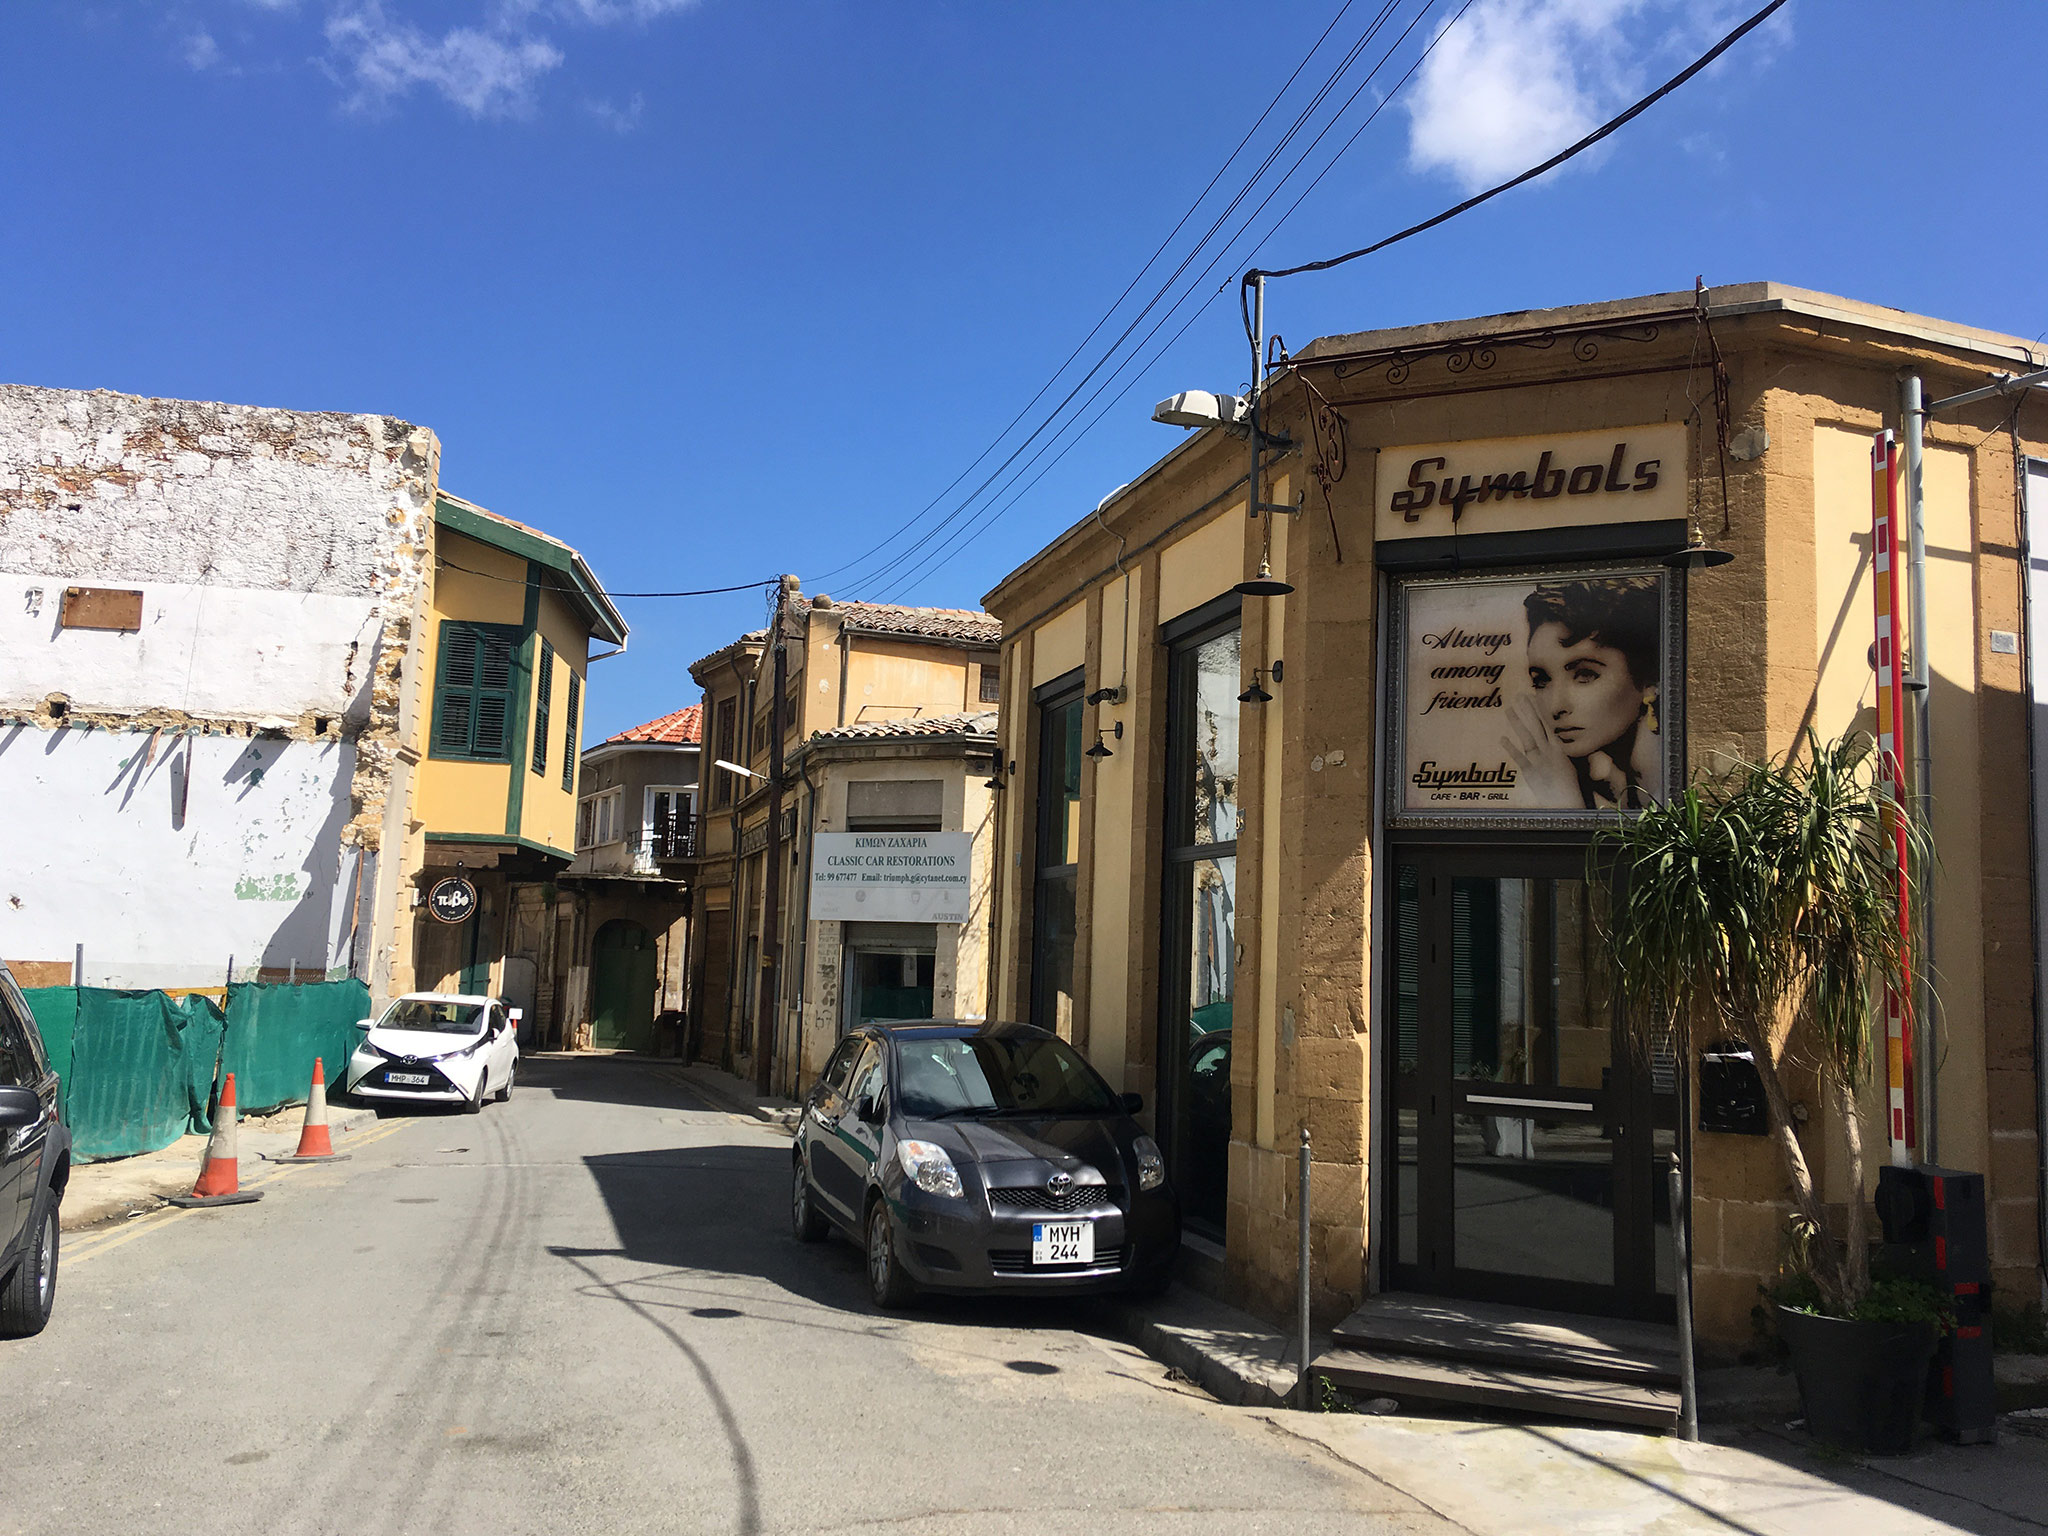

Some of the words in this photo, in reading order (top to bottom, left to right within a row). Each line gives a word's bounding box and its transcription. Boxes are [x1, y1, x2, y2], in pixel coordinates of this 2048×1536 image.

[1390, 443, 1661, 523] Symbols
[1422, 626, 1512, 656] Always
[1430, 662, 1507, 685] among
[1420, 687, 1503, 715] friends
[1412, 761, 1517, 790] Symbols
[1430, 793, 1451, 801] CAFE
[1459, 792, 1480, 801] BAR
[1487, 793, 1510, 801] GRILL
[855, 837, 886, 848] ΚΙΜΩΝ
[827, 856, 864, 866] CLASSIC
[865, 856, 885, 866] CAR
[886, 855, 955, 867] RESTORATIONS
[815, 873, 826, 881] Tel:
[827, 873, 835, 881] 99
[836, 873, 857, 881] 677477
[861, 873, 882, 881] Email:
[932, 913, 964, 921] AUSTIN
[391, 1074, 407, 1082] MHP
[411, 1075, 425, 1083] 364
[1049, 1226, 1080, 1243] MYH
[1050, 1243, 1079, 1260] 244
